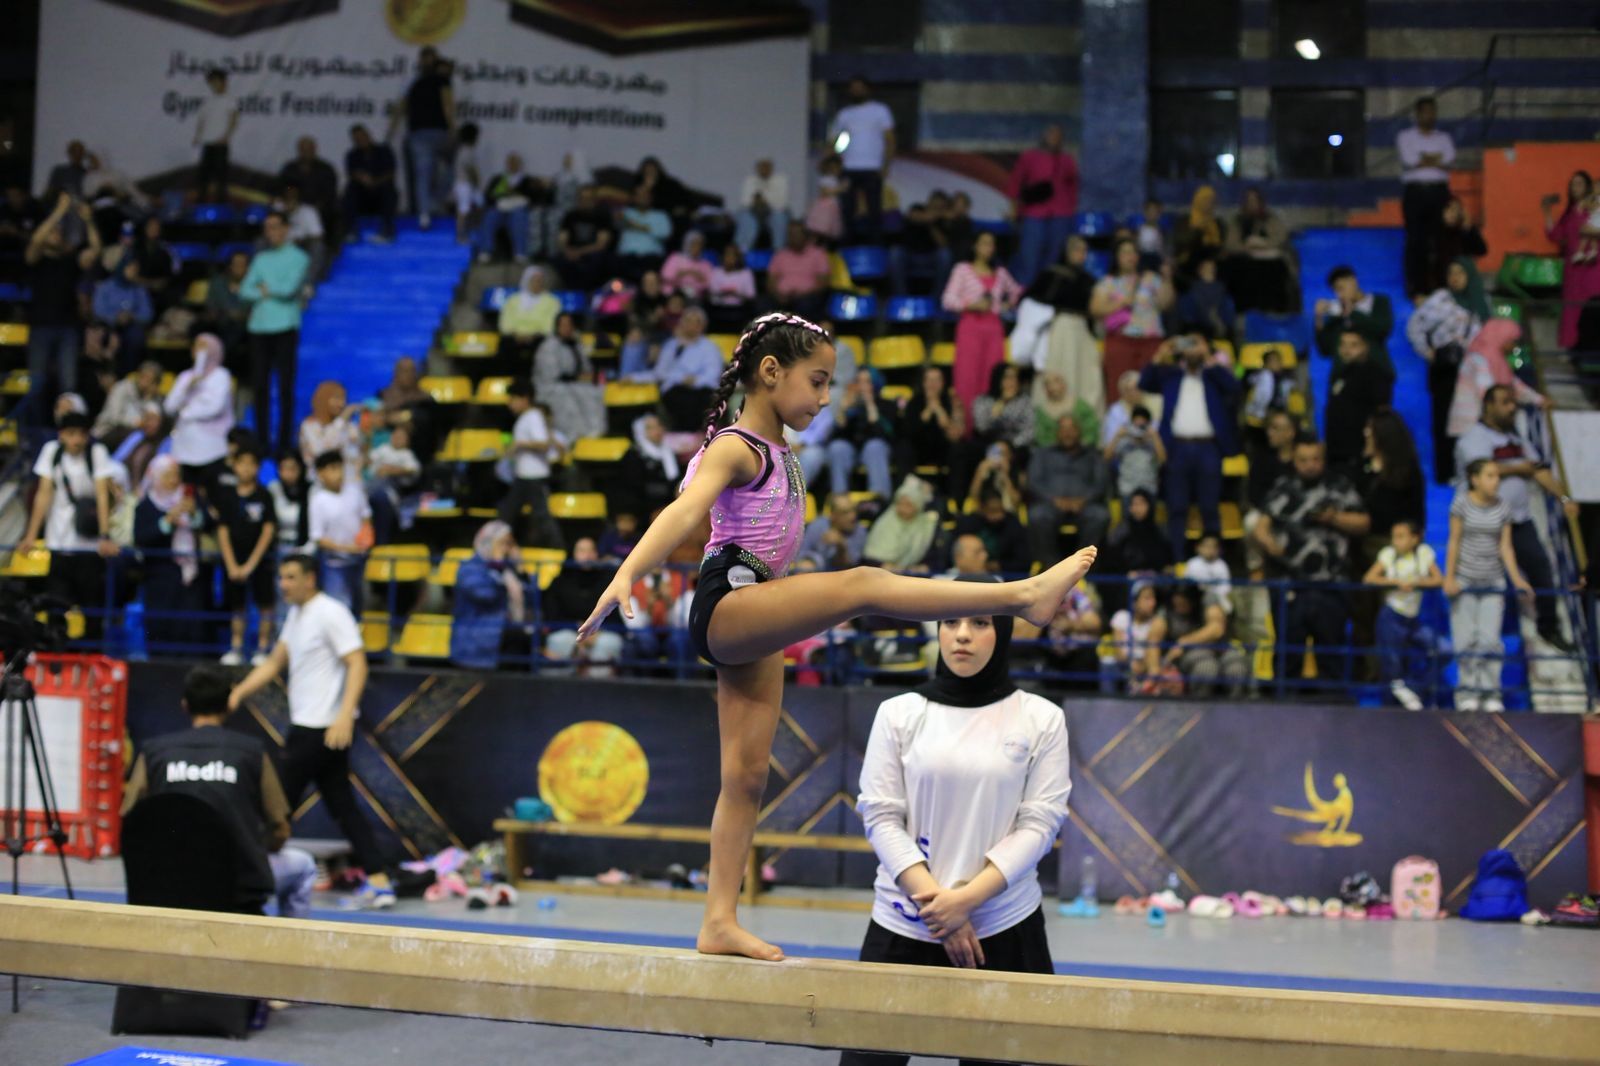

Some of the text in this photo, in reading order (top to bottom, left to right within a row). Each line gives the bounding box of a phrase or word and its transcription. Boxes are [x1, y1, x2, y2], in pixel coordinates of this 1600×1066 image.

[280, 90, 375, 116] Festivals
[523, 104, 665, 130] competitions
[166, 760, 237, 784] Media
